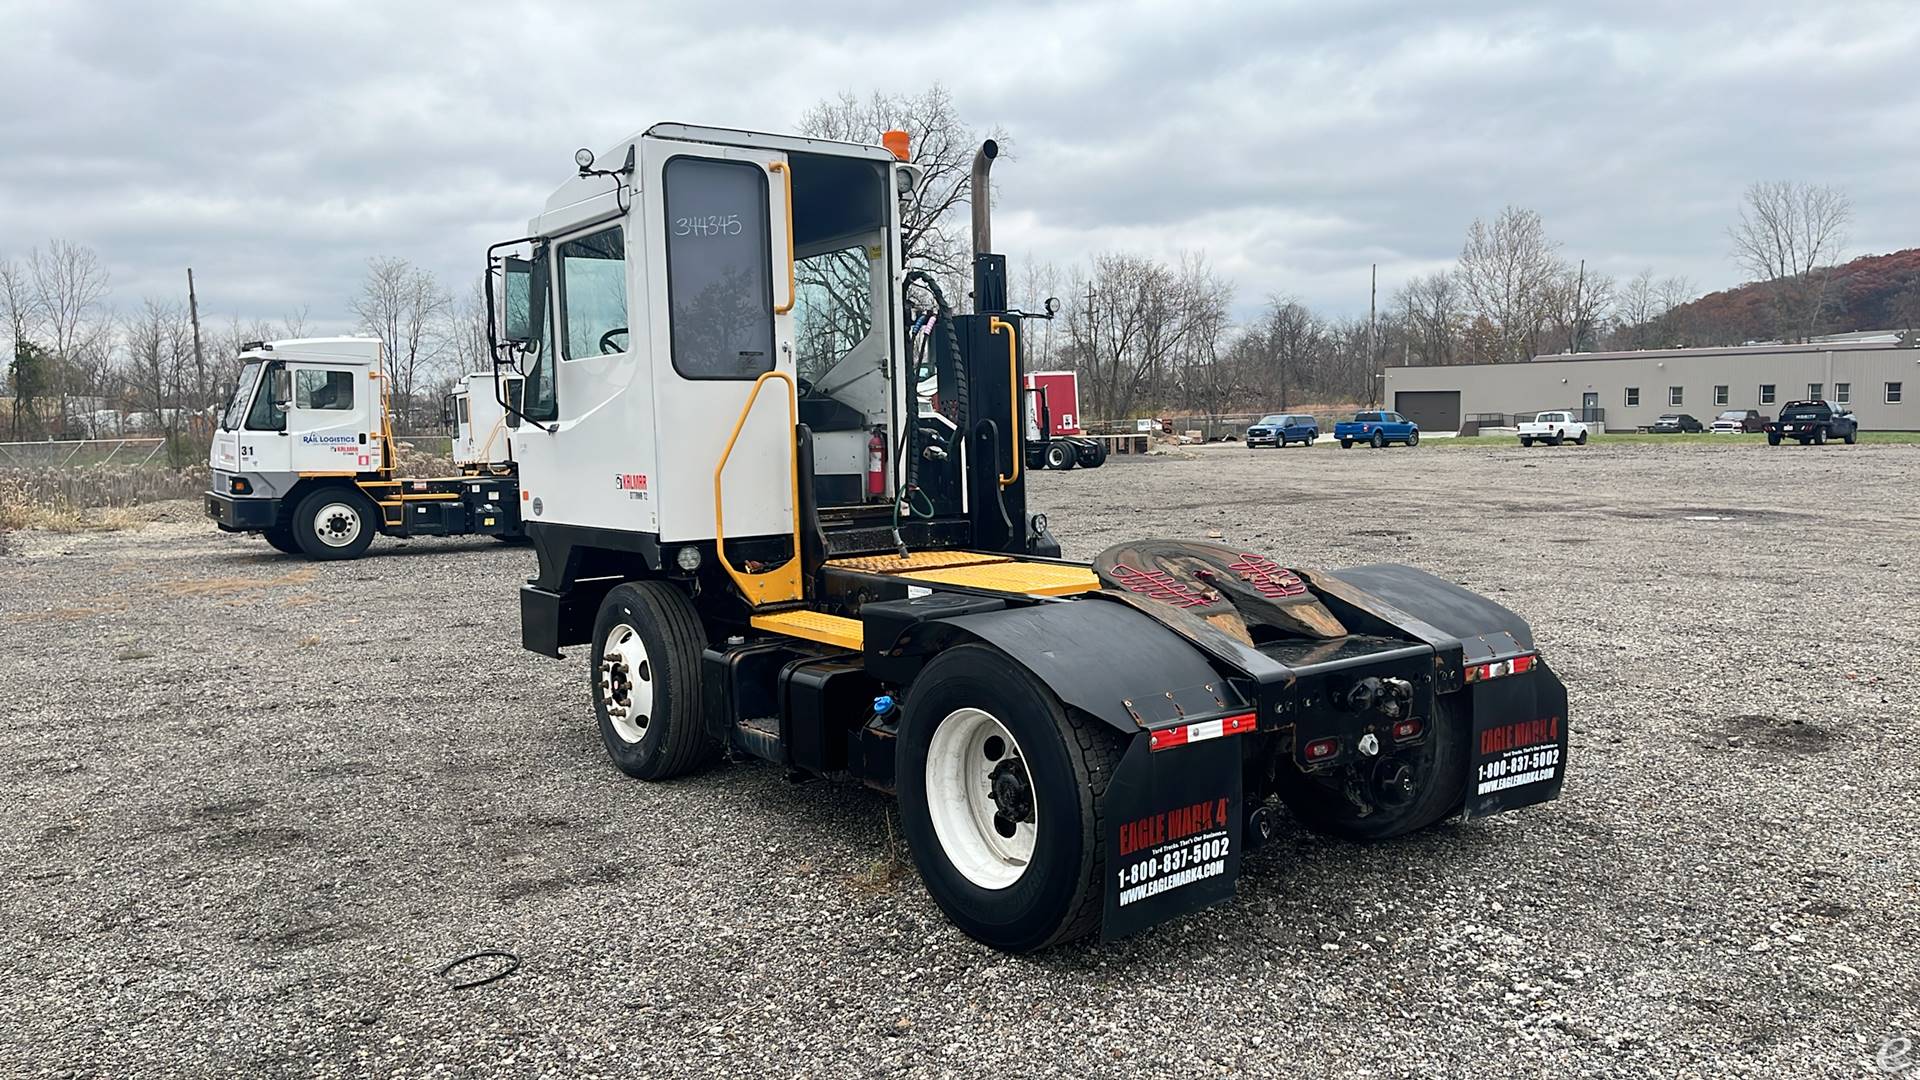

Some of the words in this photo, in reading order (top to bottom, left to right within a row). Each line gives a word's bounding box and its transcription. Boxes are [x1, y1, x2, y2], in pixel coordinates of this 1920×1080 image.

[675, 214, 742, 236] 344345
[241, 446, 253, 456] 31
[623, 474, 647, 490] KALMAR
[1481, 726, 1513, 755] EAGLE
[1515, 719, 1548, 746] MARK
[1550, 717, 1557, 740] 4
[1478, 749, 1559, 781] 1-800-837-5002
[1478, 767, 1555, 795] WWW.EAGLEMARK4.COM
[1120, 814, 1164, 856] EAGLE
[1168, 800, 1213, 839] MARK
[1216, 797, 1228, 827] 4
[1118, 837, 1229, 888] 1-800-837-5002
[1119, 860, 1225, 907] WWW.EAGLEMARK4.COM
